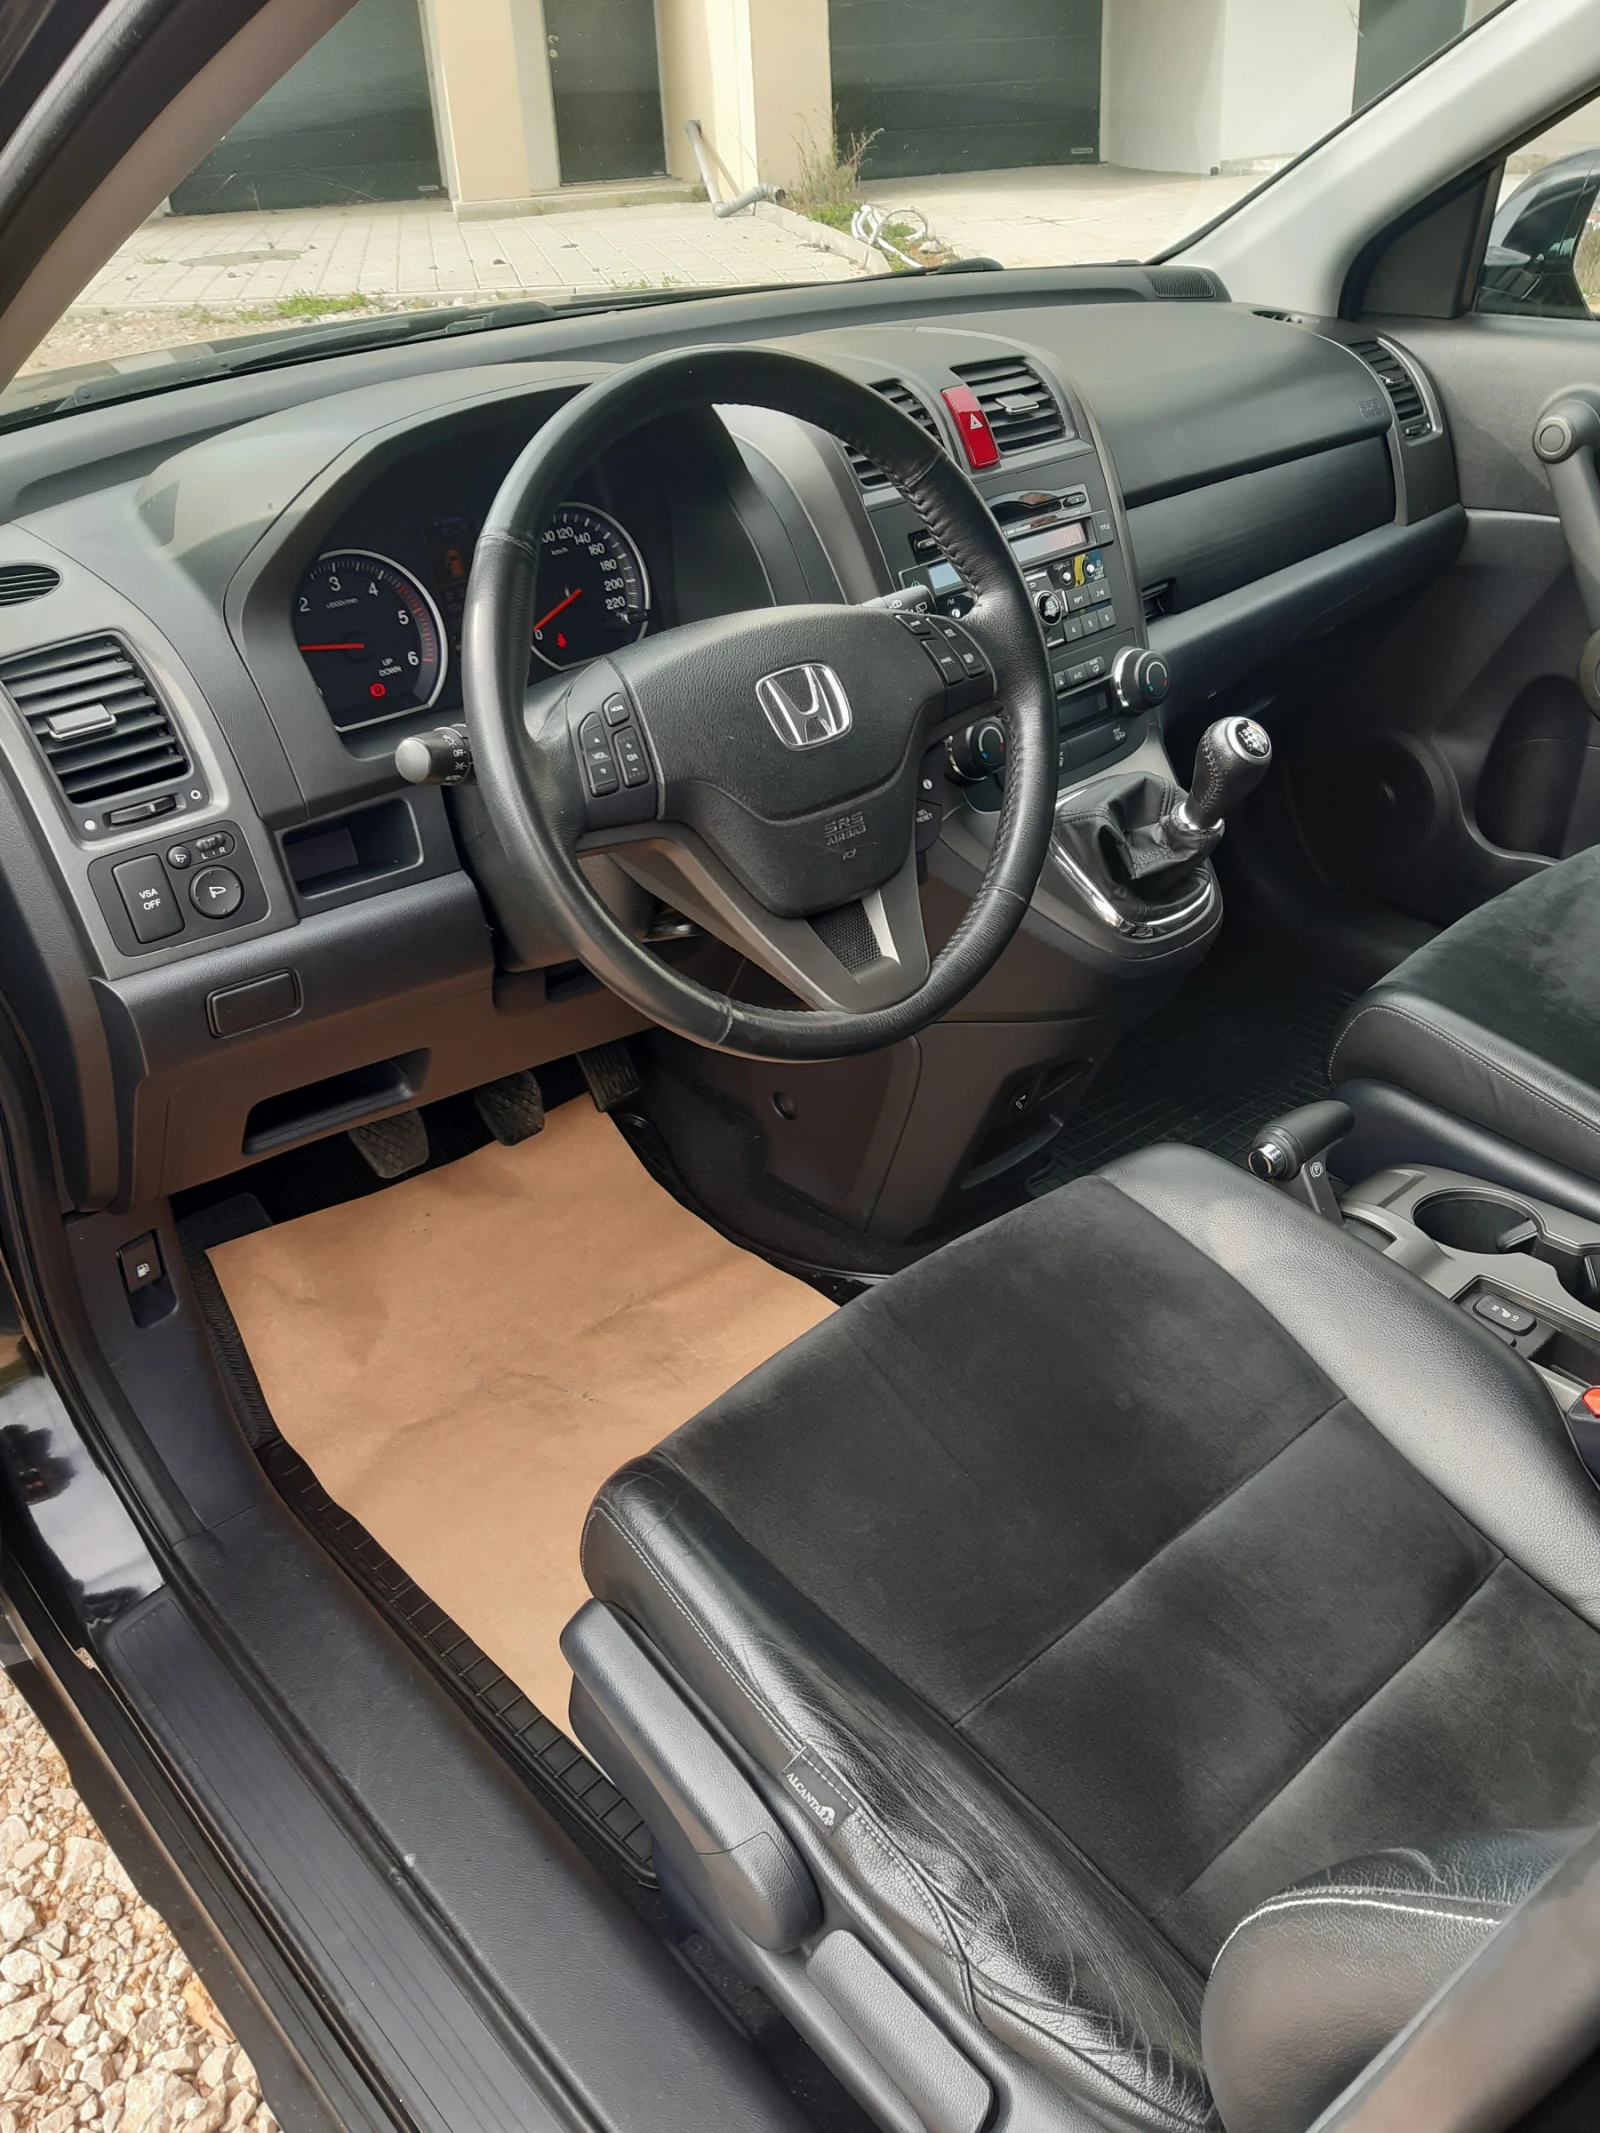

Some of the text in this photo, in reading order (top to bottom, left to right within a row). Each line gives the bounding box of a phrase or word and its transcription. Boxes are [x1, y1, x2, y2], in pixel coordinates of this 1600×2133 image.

[557, 527, 574, 540] 120
[574, 532, 591, 545] 140
[588, 543, 605, 556] 160
[600, 558, 617, 572] 180
[328, 576, 341, 591] 3
[368, 582, 379, 596] 4
[604, 577, 624, 591] 200
[298, 597, 311, 612] 2
[605, 596, 626, 610] 220
[398, 609, 409, 625] 5
[382, 657, 393, 667] UP
[407, 651, 419, 666] 6
[378, 665, 402, 677] DOWN
[1073, 671, 1083, 680] A/C
[453, 748, 464, 757] OFF
[824, 811, 864, 835] SRS
[827, 825, 867, 846] AIRBAG
[219, 846, 227, 854] R
[201, 853, 208, 861] L
[139, 887, 158, 900] VSA
[143, 898, 162, 911] OFF
[786, 1772, 831, 1826] ALCANTARA
